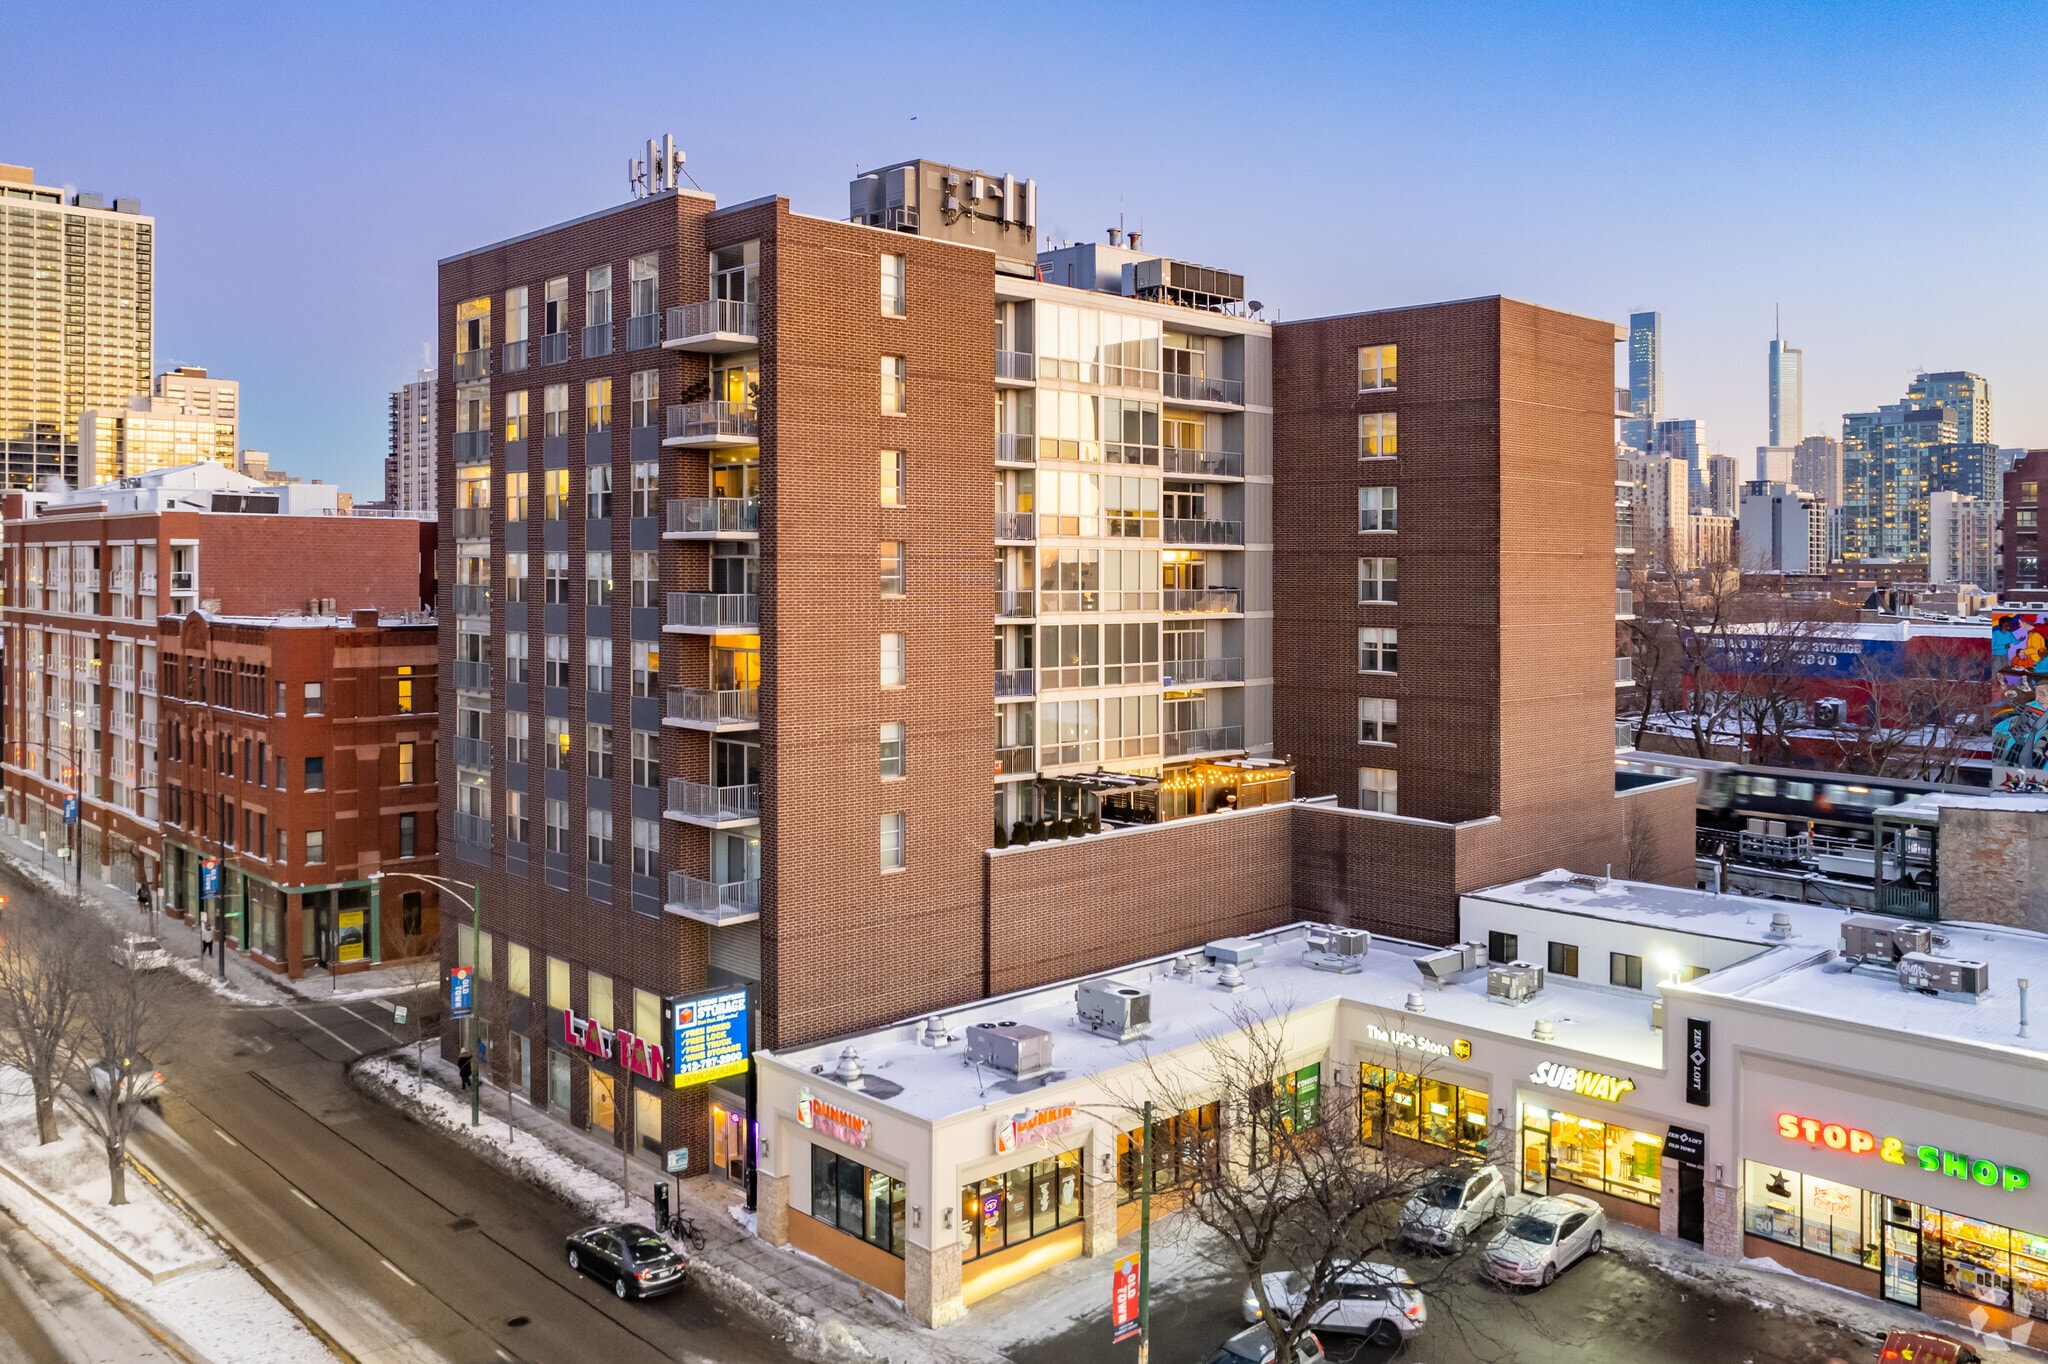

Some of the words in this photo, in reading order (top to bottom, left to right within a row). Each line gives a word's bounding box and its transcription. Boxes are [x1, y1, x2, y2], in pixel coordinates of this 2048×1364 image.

[454, 985, 462, 1008] TOWN
[462, 979, 470, 995] OLD
[698, 998, 745, 1019] STORAGE
[564, 1008, 612, 1059] L.A.
[617, 1028, 664, 1082] TAN
[685, 1036, 705, 1046] FREE
[706, 1030, 727, 1042] LOCK
[685, 1044, 705, 1054] FREE
[706, 1038, 732, 1050] TRUCK
[1366, 1024, 1389, 1042] The
[1390, 1030, 1412, 1049] UPS
[1417, 1036, 1451, 1057] Store
[1693, 1029, 1701, 1049] ZEN
[706, 1043, 741, 1057] STORAGE
[1529, 1061, 1636, 1102] SUBWAY
[1693, 1066, 1701, 1090] LOFT
[813, 1115, 865, 1149] DONUTS
[1688, 1137, 1702, 1145] LOFT
[1680, 1145, 1696, 1153] TOWN
[1778, 1113, 1875, 1155] STOP
[1880, 1136, 1905, 1165] &
[1917, 1145, 2030, 1192] SHOP
[1127, 1273, 1136, 1300] OLD
[1117, 1284, 1128, 1324] TOWN
